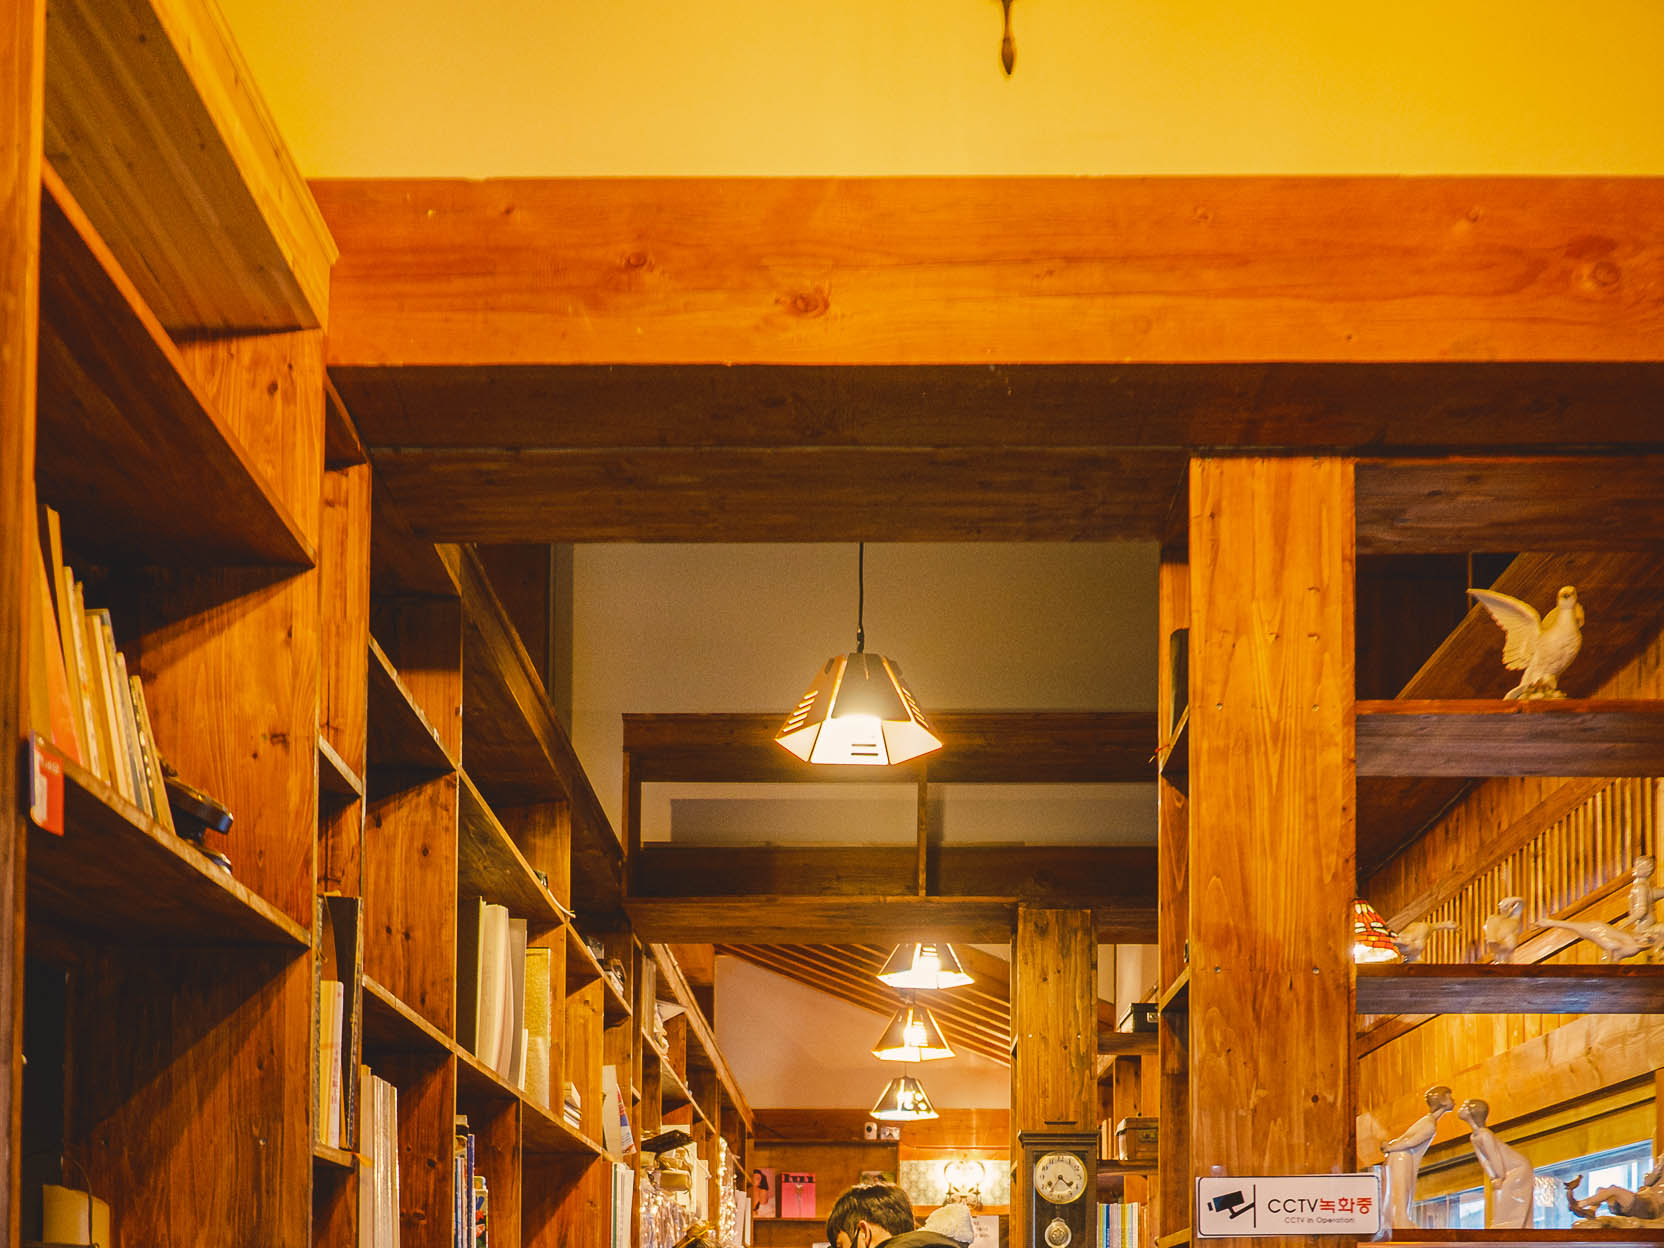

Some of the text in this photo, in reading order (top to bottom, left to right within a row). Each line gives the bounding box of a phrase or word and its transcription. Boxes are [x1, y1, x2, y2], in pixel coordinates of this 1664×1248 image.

[1267, 1197, 1372, 1214] CCTV녹화중
[1284, 1216, 1305, 1224] CCTV
[1316, 1216, 1355, 1225] Operation
